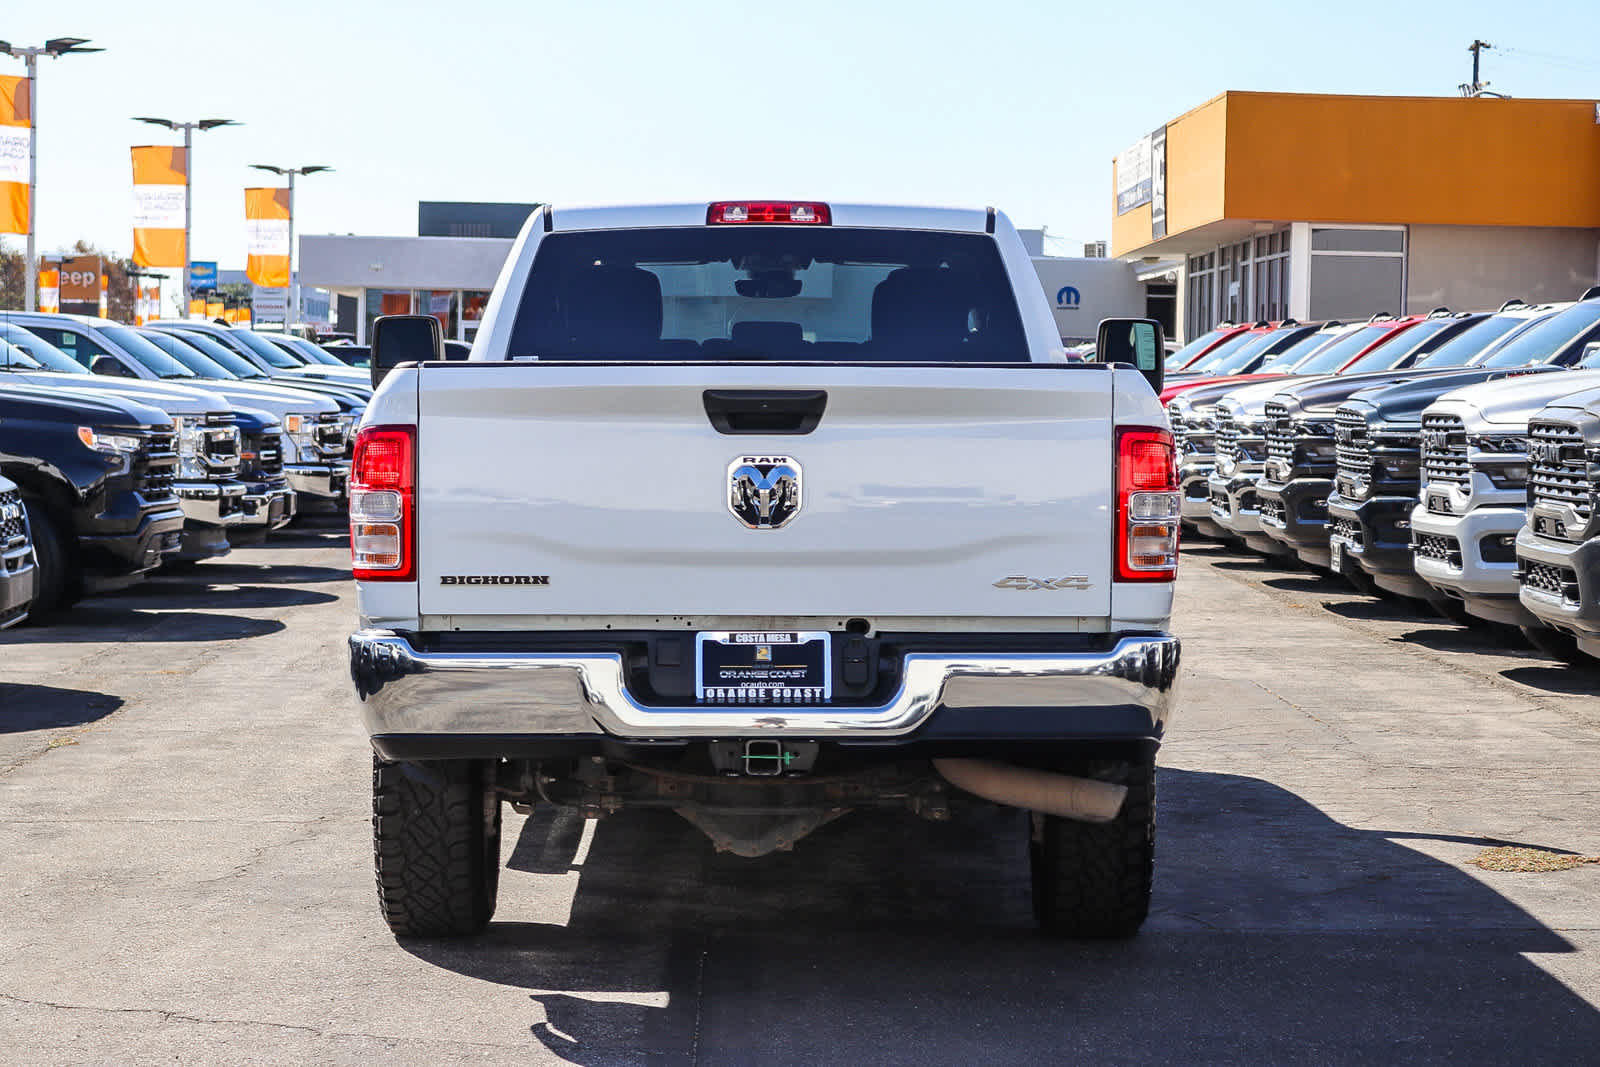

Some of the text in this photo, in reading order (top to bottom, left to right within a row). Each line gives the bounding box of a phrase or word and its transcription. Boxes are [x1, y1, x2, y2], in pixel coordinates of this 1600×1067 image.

[59, 272, 95, 288] eep
[440, 576, 550, 585] BIGHORN
[735, 633, 791, 642] COSTA MESA
[720, 670, 808, 678] ORANGE COAST
[706, 688, 822, 698] ORANGE COAST
